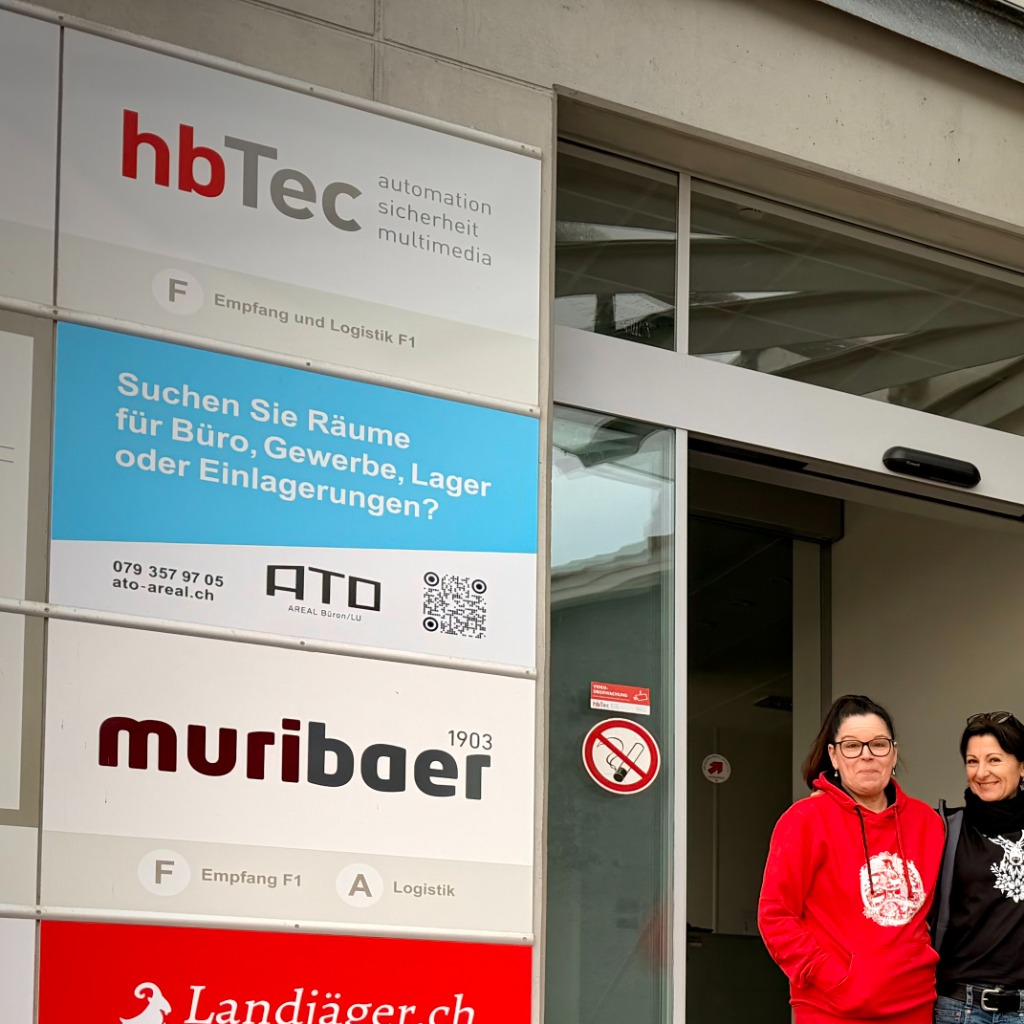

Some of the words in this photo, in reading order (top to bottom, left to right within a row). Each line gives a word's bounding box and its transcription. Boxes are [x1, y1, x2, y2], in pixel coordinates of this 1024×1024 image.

[122, 109, 363, 232] hbTec
[378, 175, 492, 216] automation
[378, 200, 478, 237] sicherheit
[378, 228, 492, 266] multimedia
[169, 278, 188, 303] F
[214, 293, 289, 324] Empfang
[294, 311, 325, 328] und
[331, 318, 394, 344] Logistik
[399, 333, 416, 348] F1
[118, 372, 240, 417] Suchen
[250, 399, 298, 427] Sie
[308, 408, 410, 448] Räume
[116, 408, 162, 438] für
[172, 421, 257, 459] Büro,
[264, 437, 403, 485] Gewerbe,
[412, 463, 492, 499] Lager
[115, 449, 190, 477] oder
[200, 459, 439, 520] Einlagerungen?
[112, 578, 214, 601] ato-areal.ch
[113, 560, 143, 576] 079
[148, 565, 177, 581] 357
[182, 568, 200, 583] 97
[204, 573, 224, 587] 05
[266, 564, 381, 611] ATO
[288, 604, 318, 616] AREAL
[99, 717, 491, 800] muribaer
[448, 730, 493, 750] 1903
[155, 860, 174, 884] F
[202, 868, 277, 888] Empfang
[283, 874, 301, 887] F1
[348, 874, 372, 897] A
[393, 881, 455, 897] Logistik
